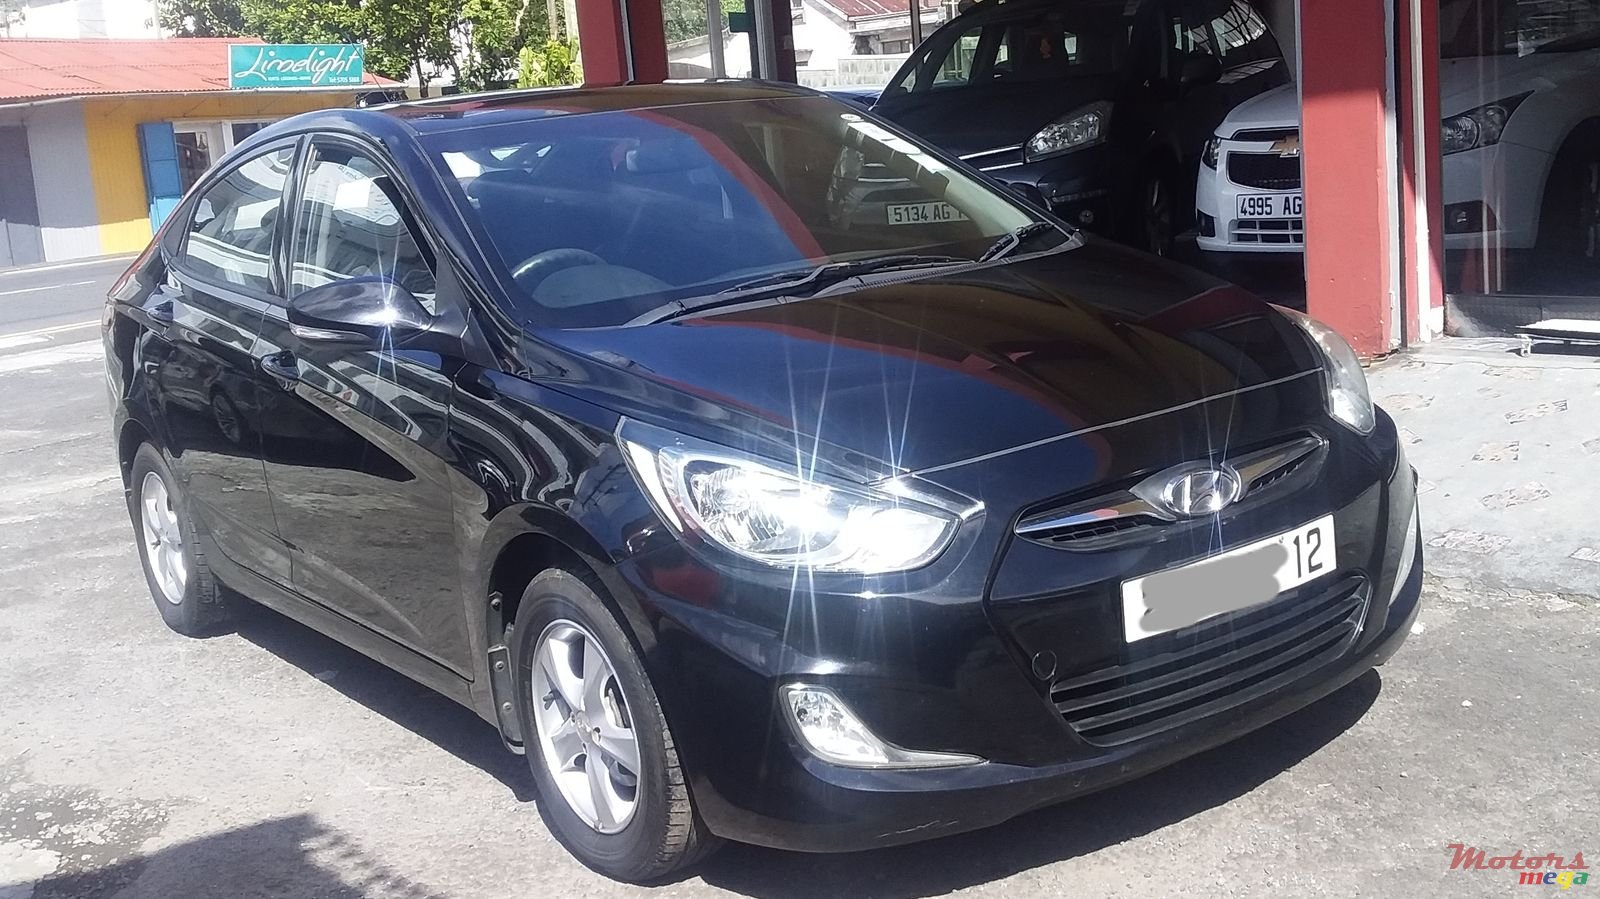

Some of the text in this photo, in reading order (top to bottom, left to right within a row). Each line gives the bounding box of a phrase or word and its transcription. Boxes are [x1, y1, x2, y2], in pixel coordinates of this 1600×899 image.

[235, 47, 360, 84] Limelight
[894, 205, 928, 222] 5134
[933, 204, 950, 220] AG
[1240, 196, 1302, 216] 4995 AG
[1293, 527, 1323, 578] 12
